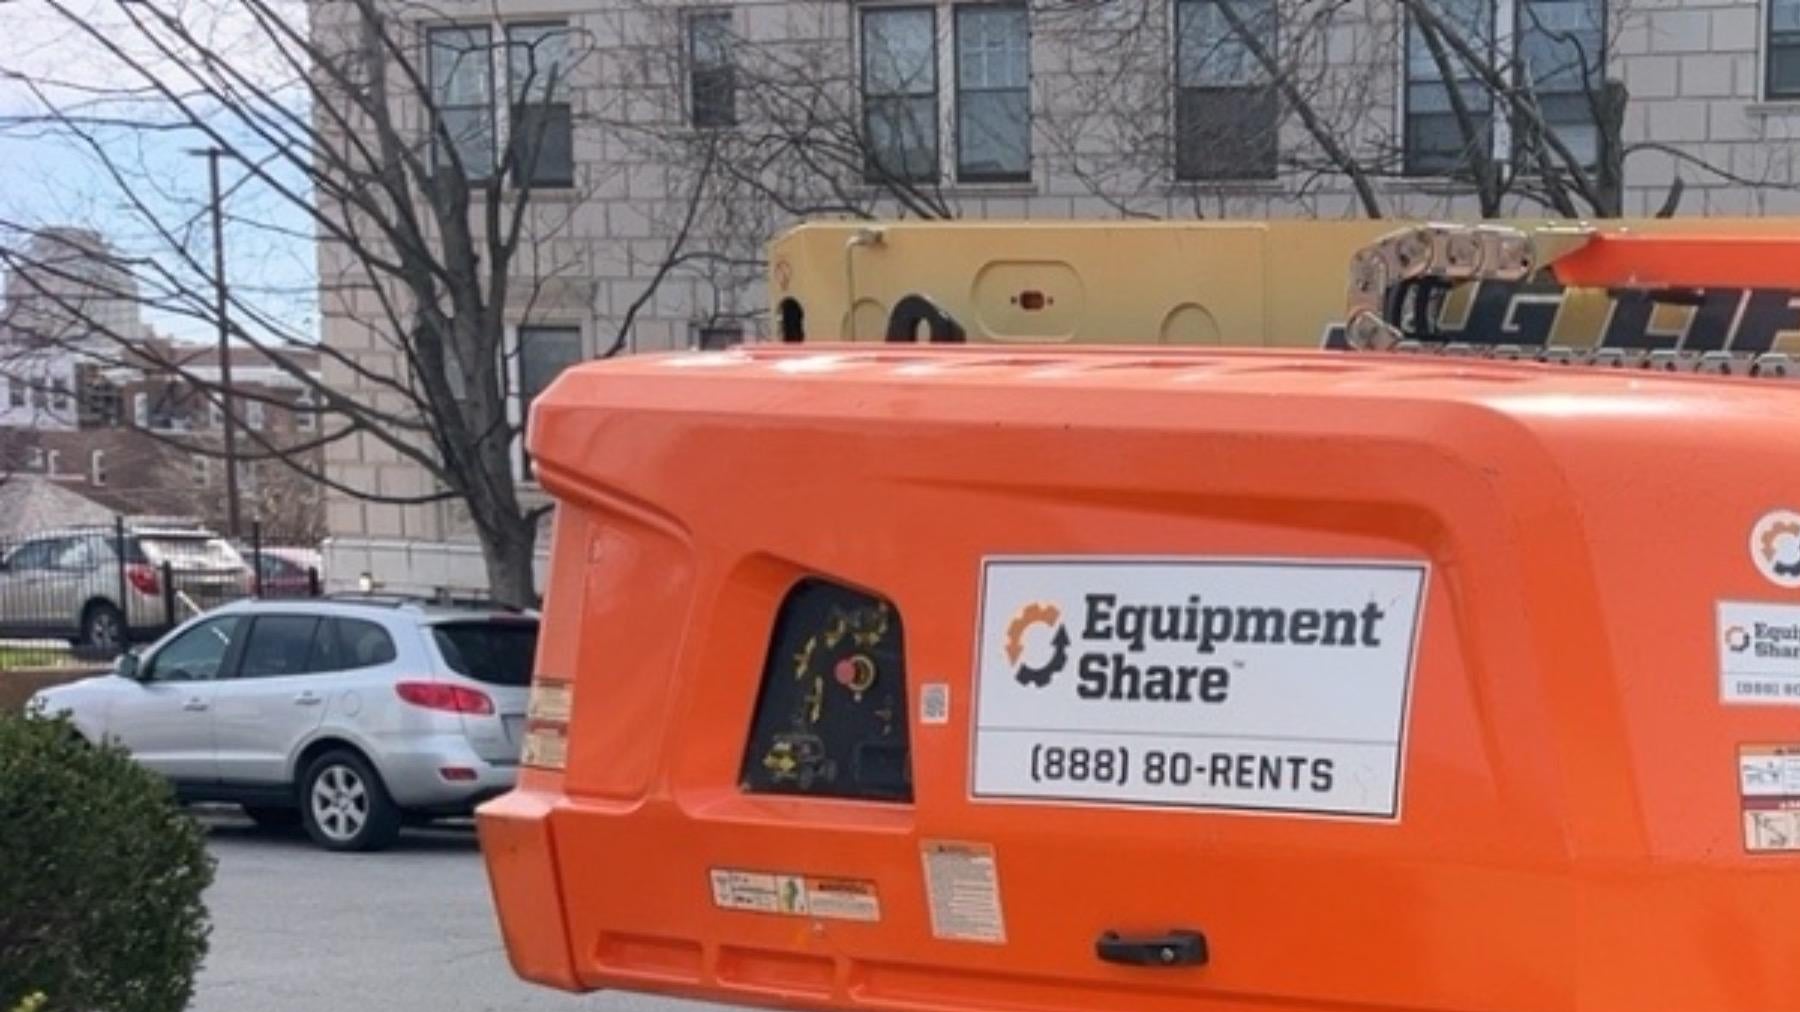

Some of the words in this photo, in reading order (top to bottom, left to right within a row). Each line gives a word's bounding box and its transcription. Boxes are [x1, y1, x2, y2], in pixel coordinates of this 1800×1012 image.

[1082, 594, 1384, 654] Equipment
[1076, 652, 1230, 703] Share
[1030, 744, 1128, 786] (888)
[1143, 750, 1334, 792] 80-RENTS
